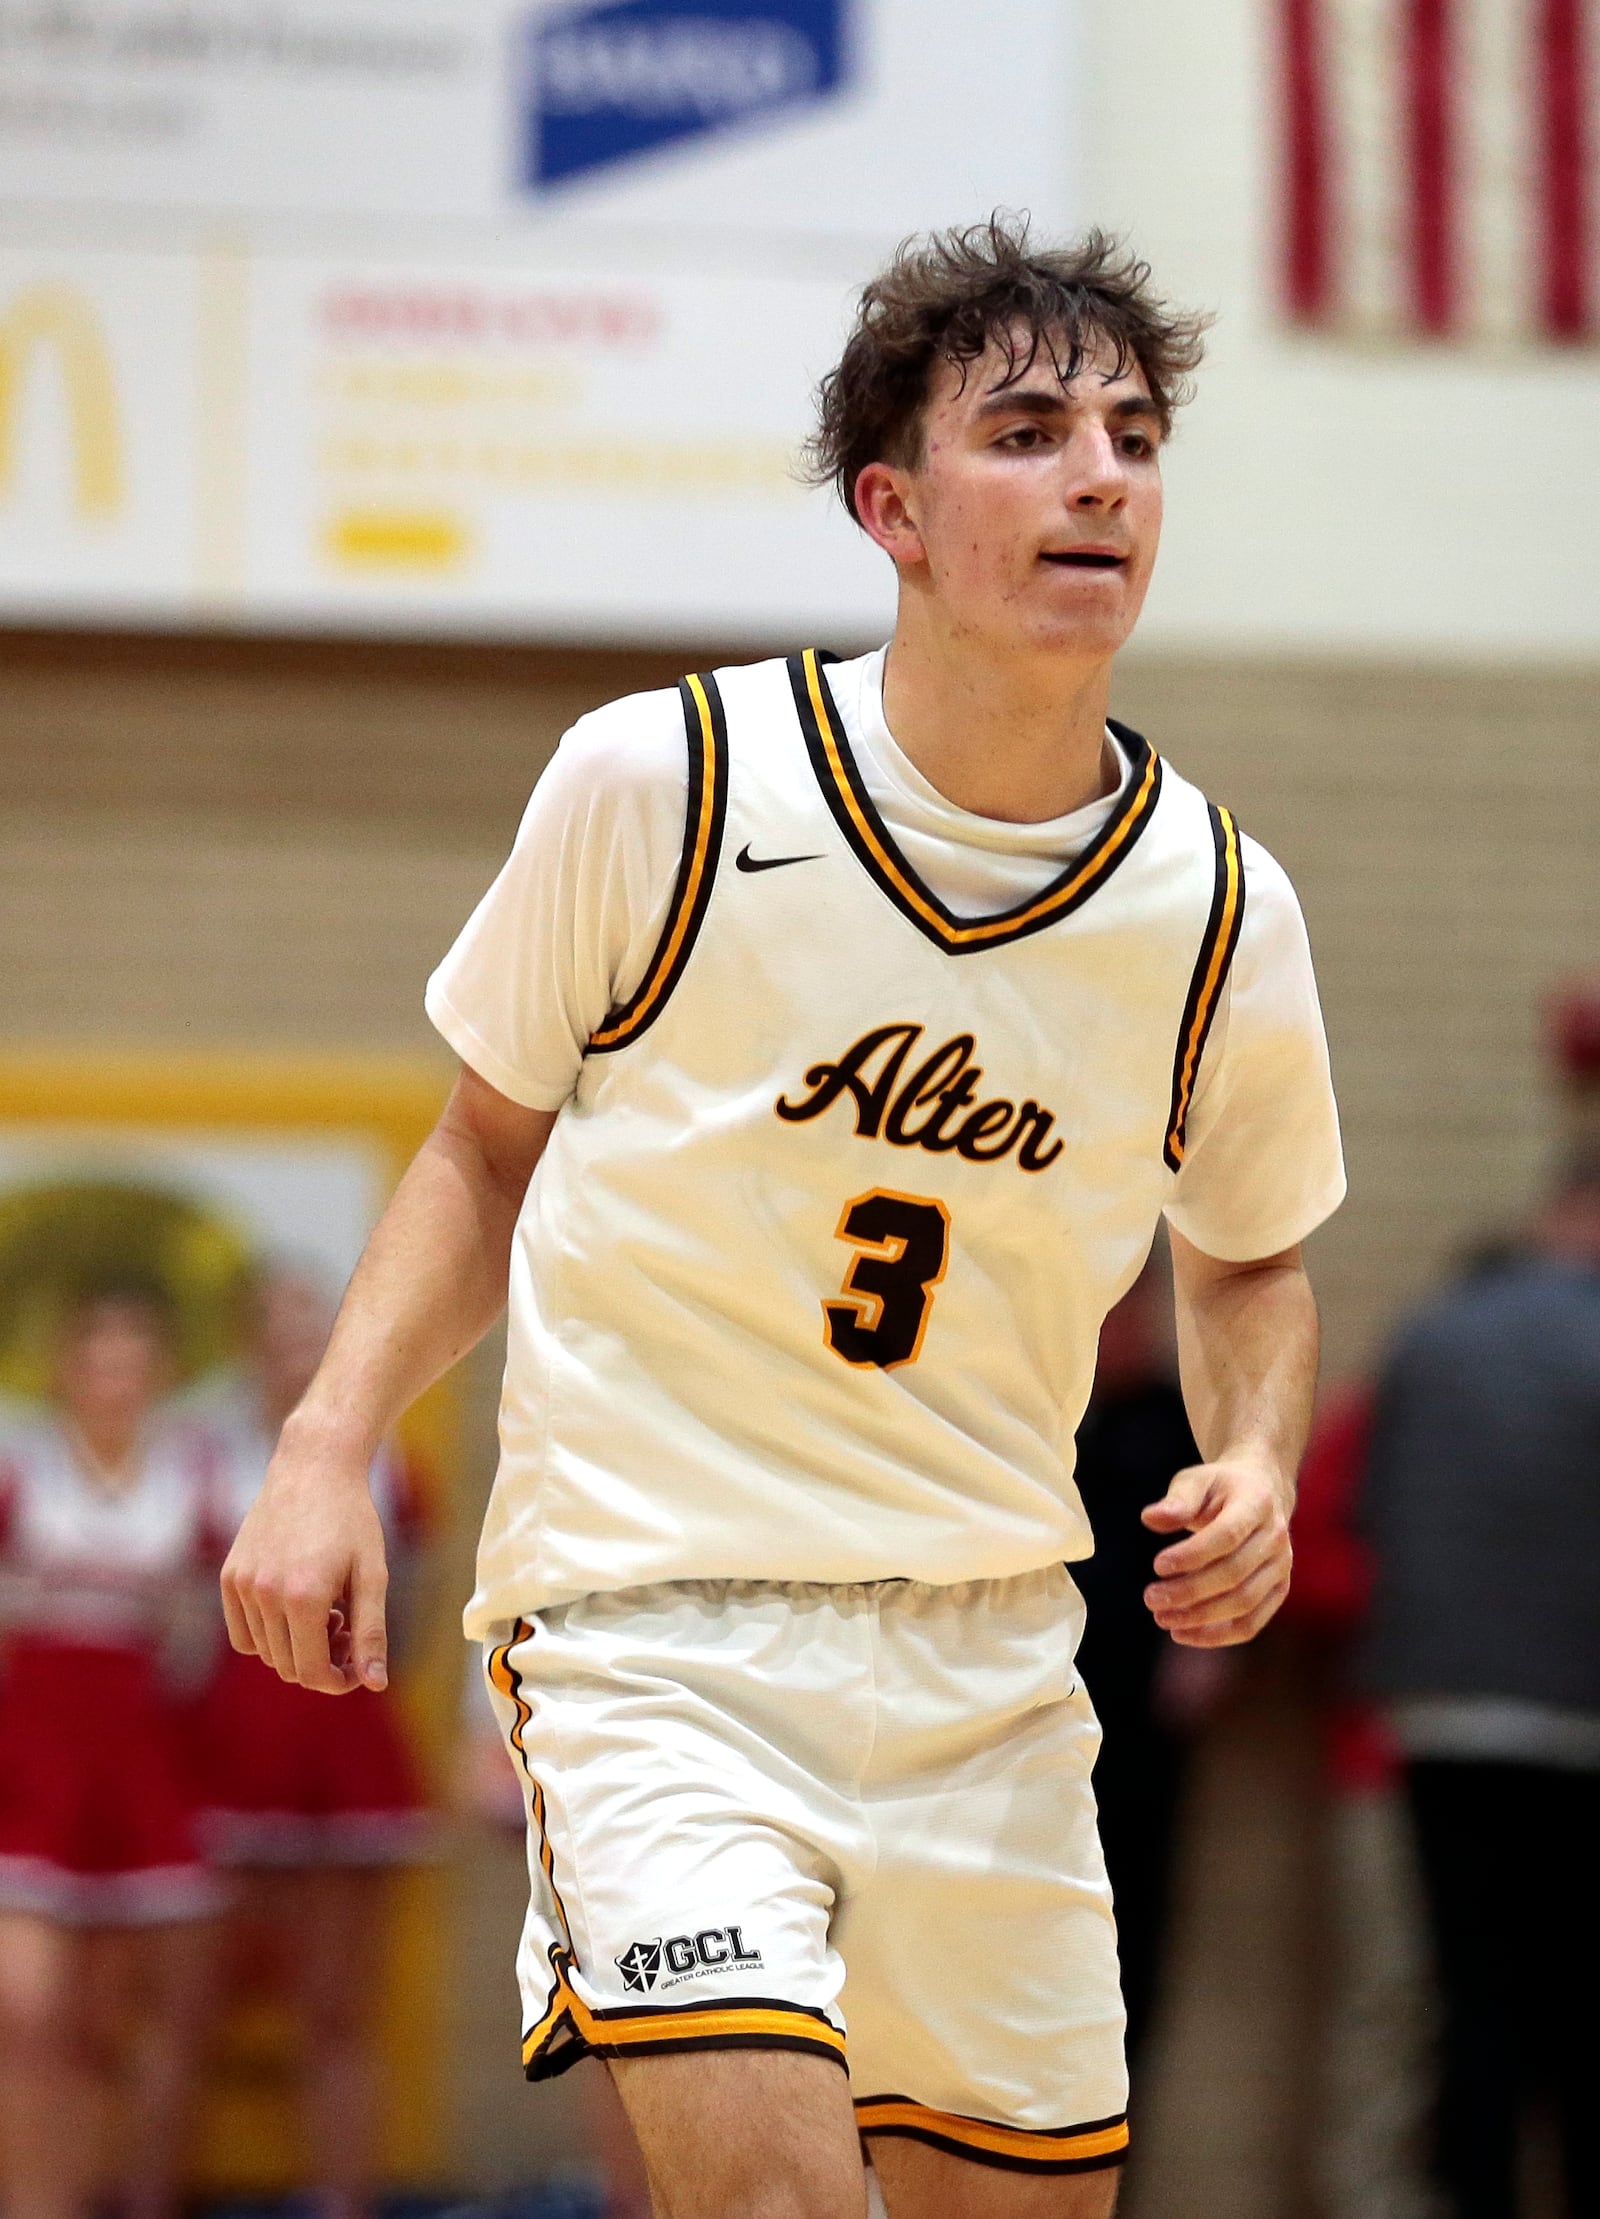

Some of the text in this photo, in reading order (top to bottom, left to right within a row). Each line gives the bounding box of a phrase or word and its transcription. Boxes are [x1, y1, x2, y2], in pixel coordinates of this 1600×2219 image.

[774, 1020, 1065, 1174] Alter
[820, 1187, 952, 1372] 3
[661, 1962, 765, 1990] GREATER CATHOLIC LEAGUE
[663, 1926, 762, 1975] GCL
